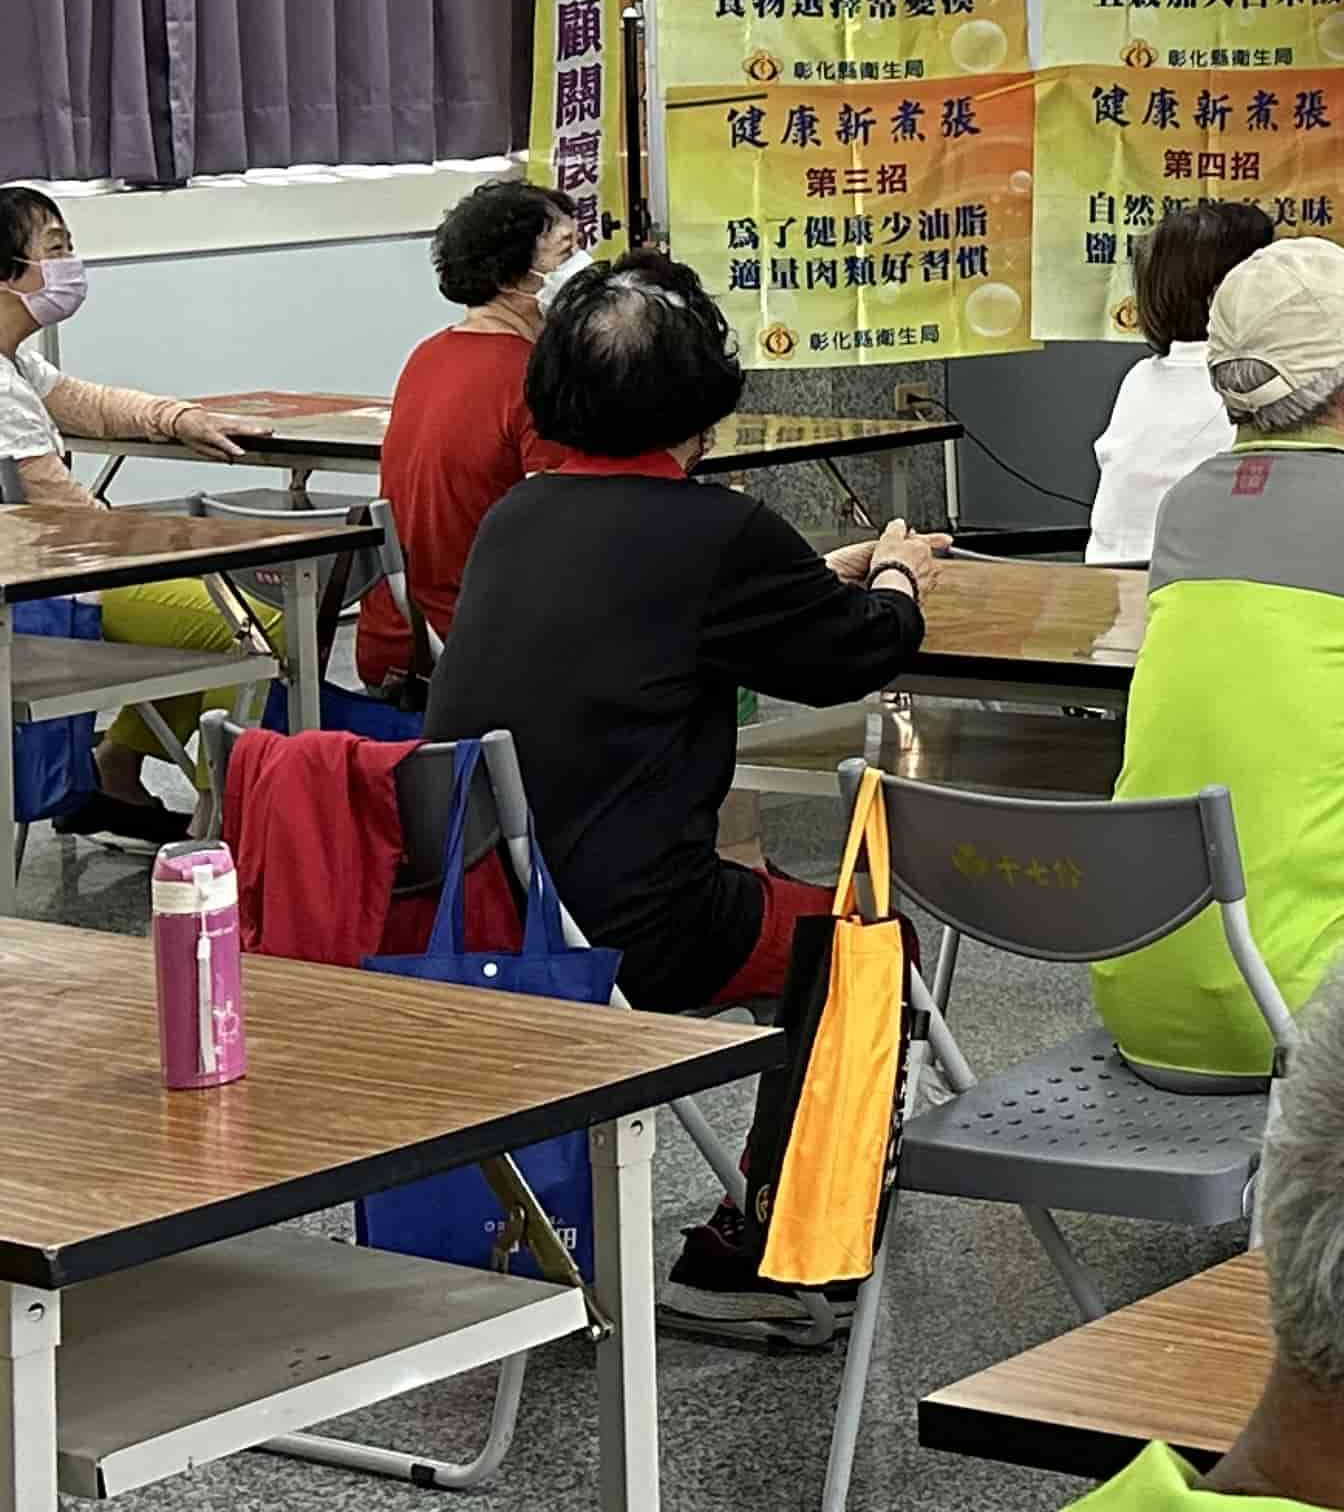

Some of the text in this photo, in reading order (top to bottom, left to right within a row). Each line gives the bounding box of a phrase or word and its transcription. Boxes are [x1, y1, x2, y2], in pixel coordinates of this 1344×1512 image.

[792, 59, 925, 81] 彰化縣衛生局
[1167, 47, 1294, 67] 彰化縣衛生局
[726, 95, 982, 149] 健康新煮張
[1091, 84, 1332, 133] 健康新煮張
[805, 163, 909, 199] 第三招
[1164, 148, 1262, 181] 第四招
[1088, 192, 1333, 227] 自然新美味
[728, 244, 990, 291] 適量肉類好習慣
[809, 324, 941, 352] 彰化縣衛生局
